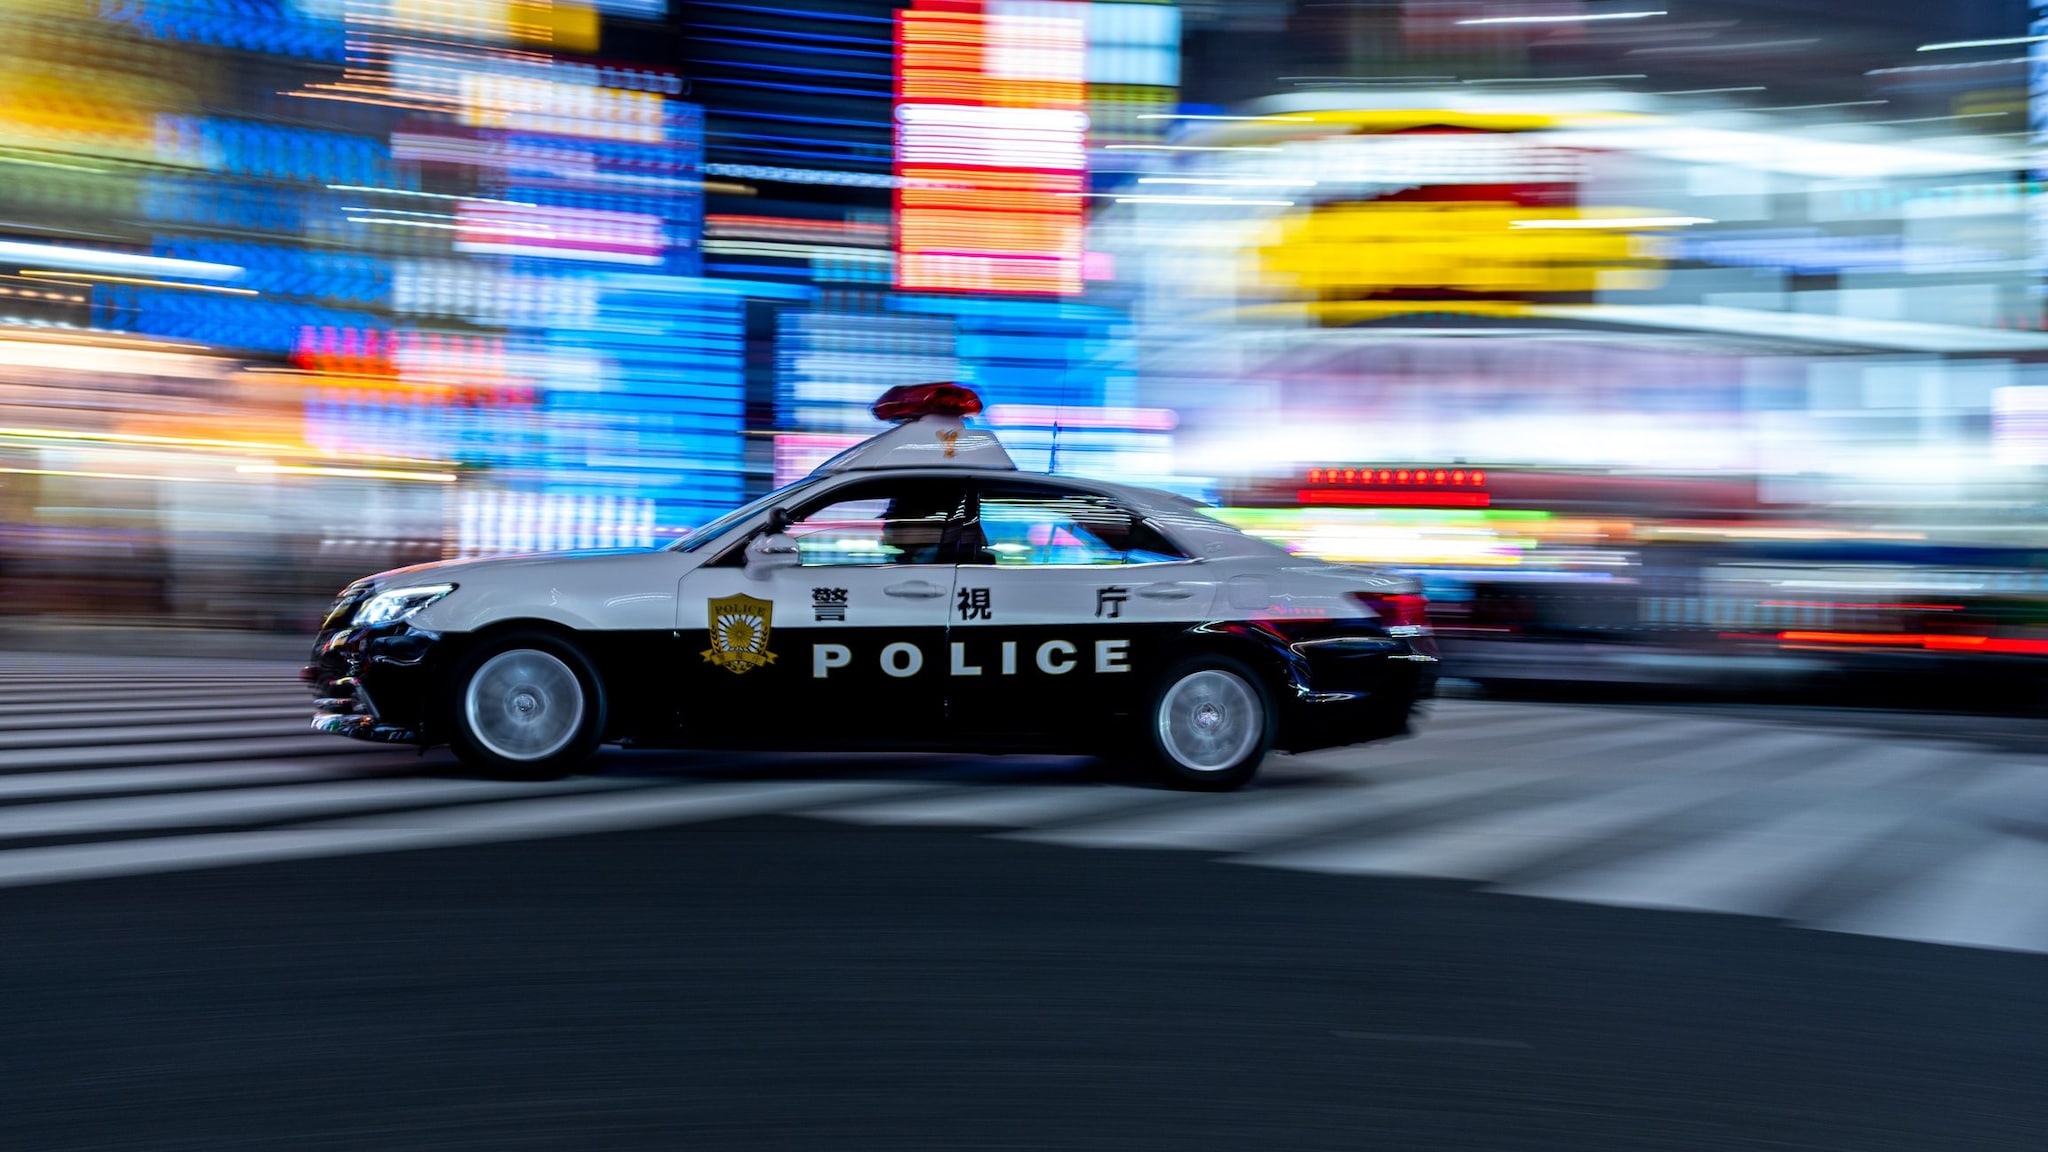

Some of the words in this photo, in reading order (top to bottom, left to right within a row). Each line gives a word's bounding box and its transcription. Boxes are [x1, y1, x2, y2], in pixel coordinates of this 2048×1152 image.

[714, 604, 766, 616] POLICE
[812, 586, 1128, 621] 警視庁
[813, 640, 1131, 678] POLICE
